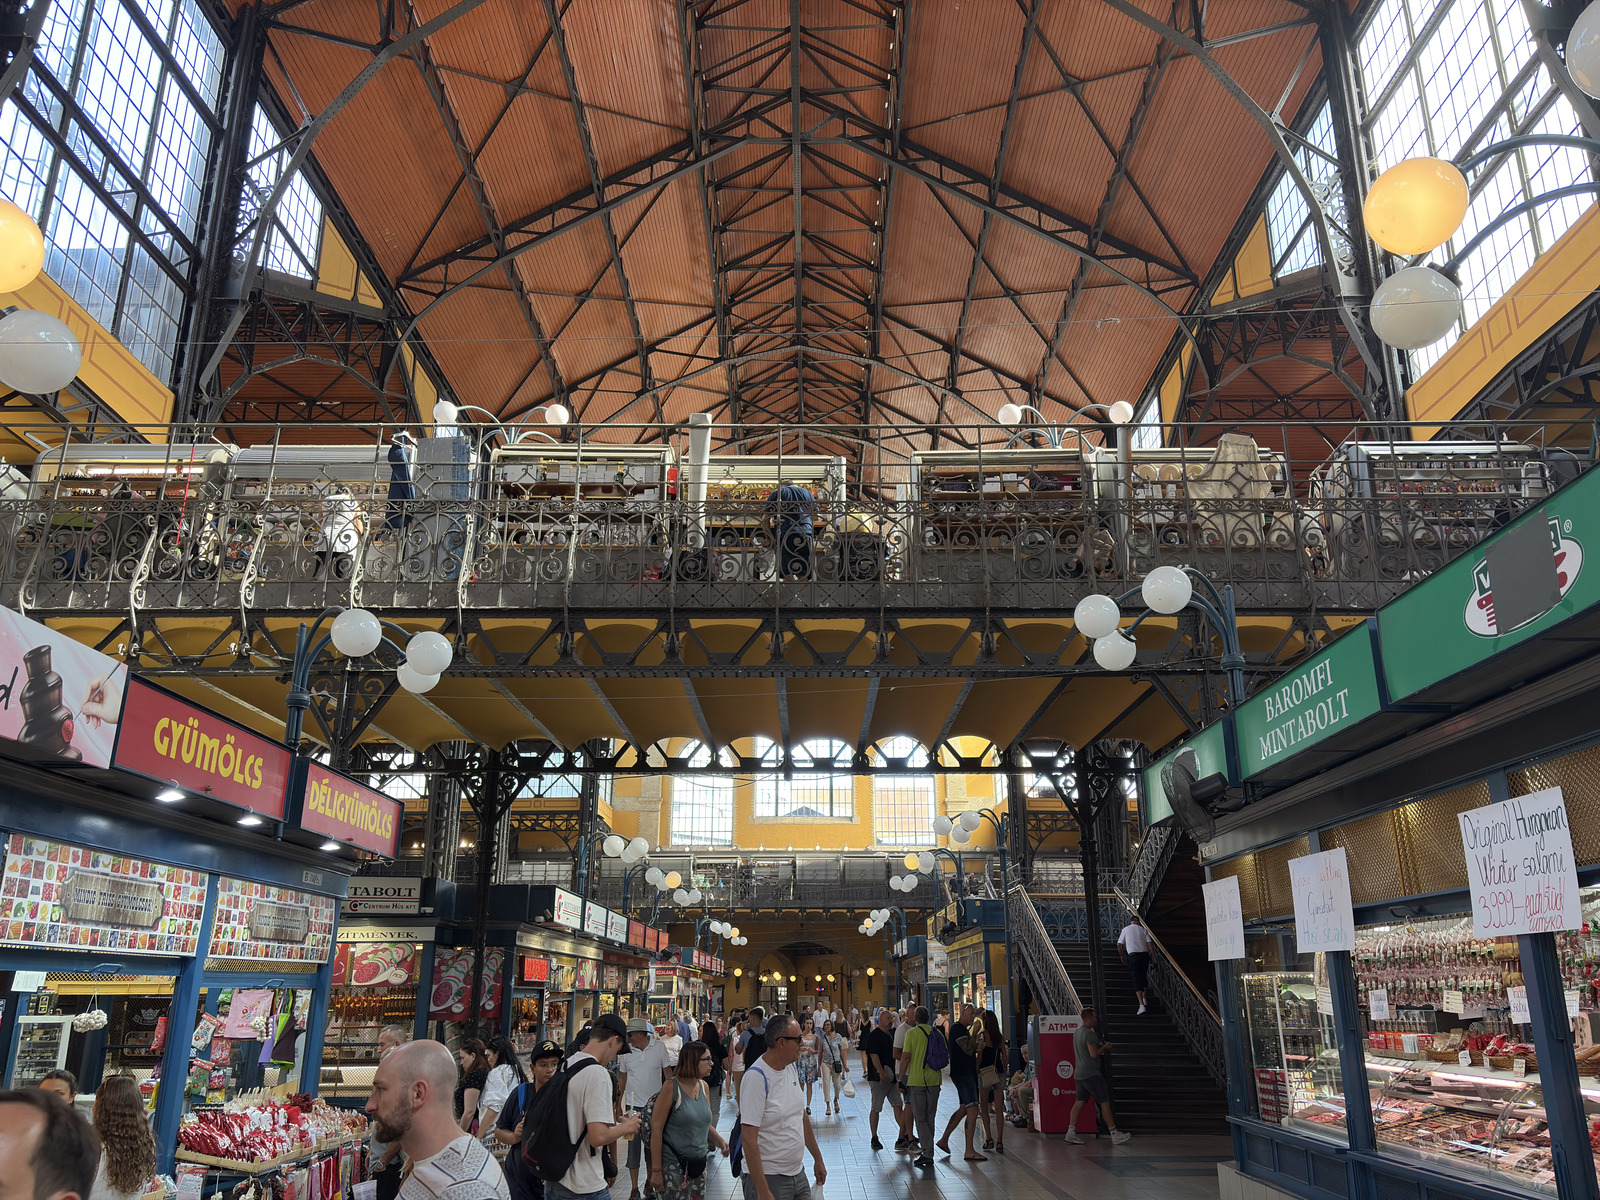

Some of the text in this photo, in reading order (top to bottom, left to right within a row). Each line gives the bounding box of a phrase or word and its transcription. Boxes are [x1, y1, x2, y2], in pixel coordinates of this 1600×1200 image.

[1264, 658, 1333, 722] BAROMFI
[1259, 688, 1349, 760] MINTABOLT
[154, 716, 264, 789] GYÜMÖLCS
[308, 778, 393, 839] DÉLIGYÜMÖLCS
[1463, 801, 1515, 857] Original
[348, 886, 416, 897] TABOLT
[1475, 841, 1567, 887] Winter salami
[338, 930, 418, 939] ZÍTMÉNYEK,
[1048, 1023, 1068, 1031] ATM
